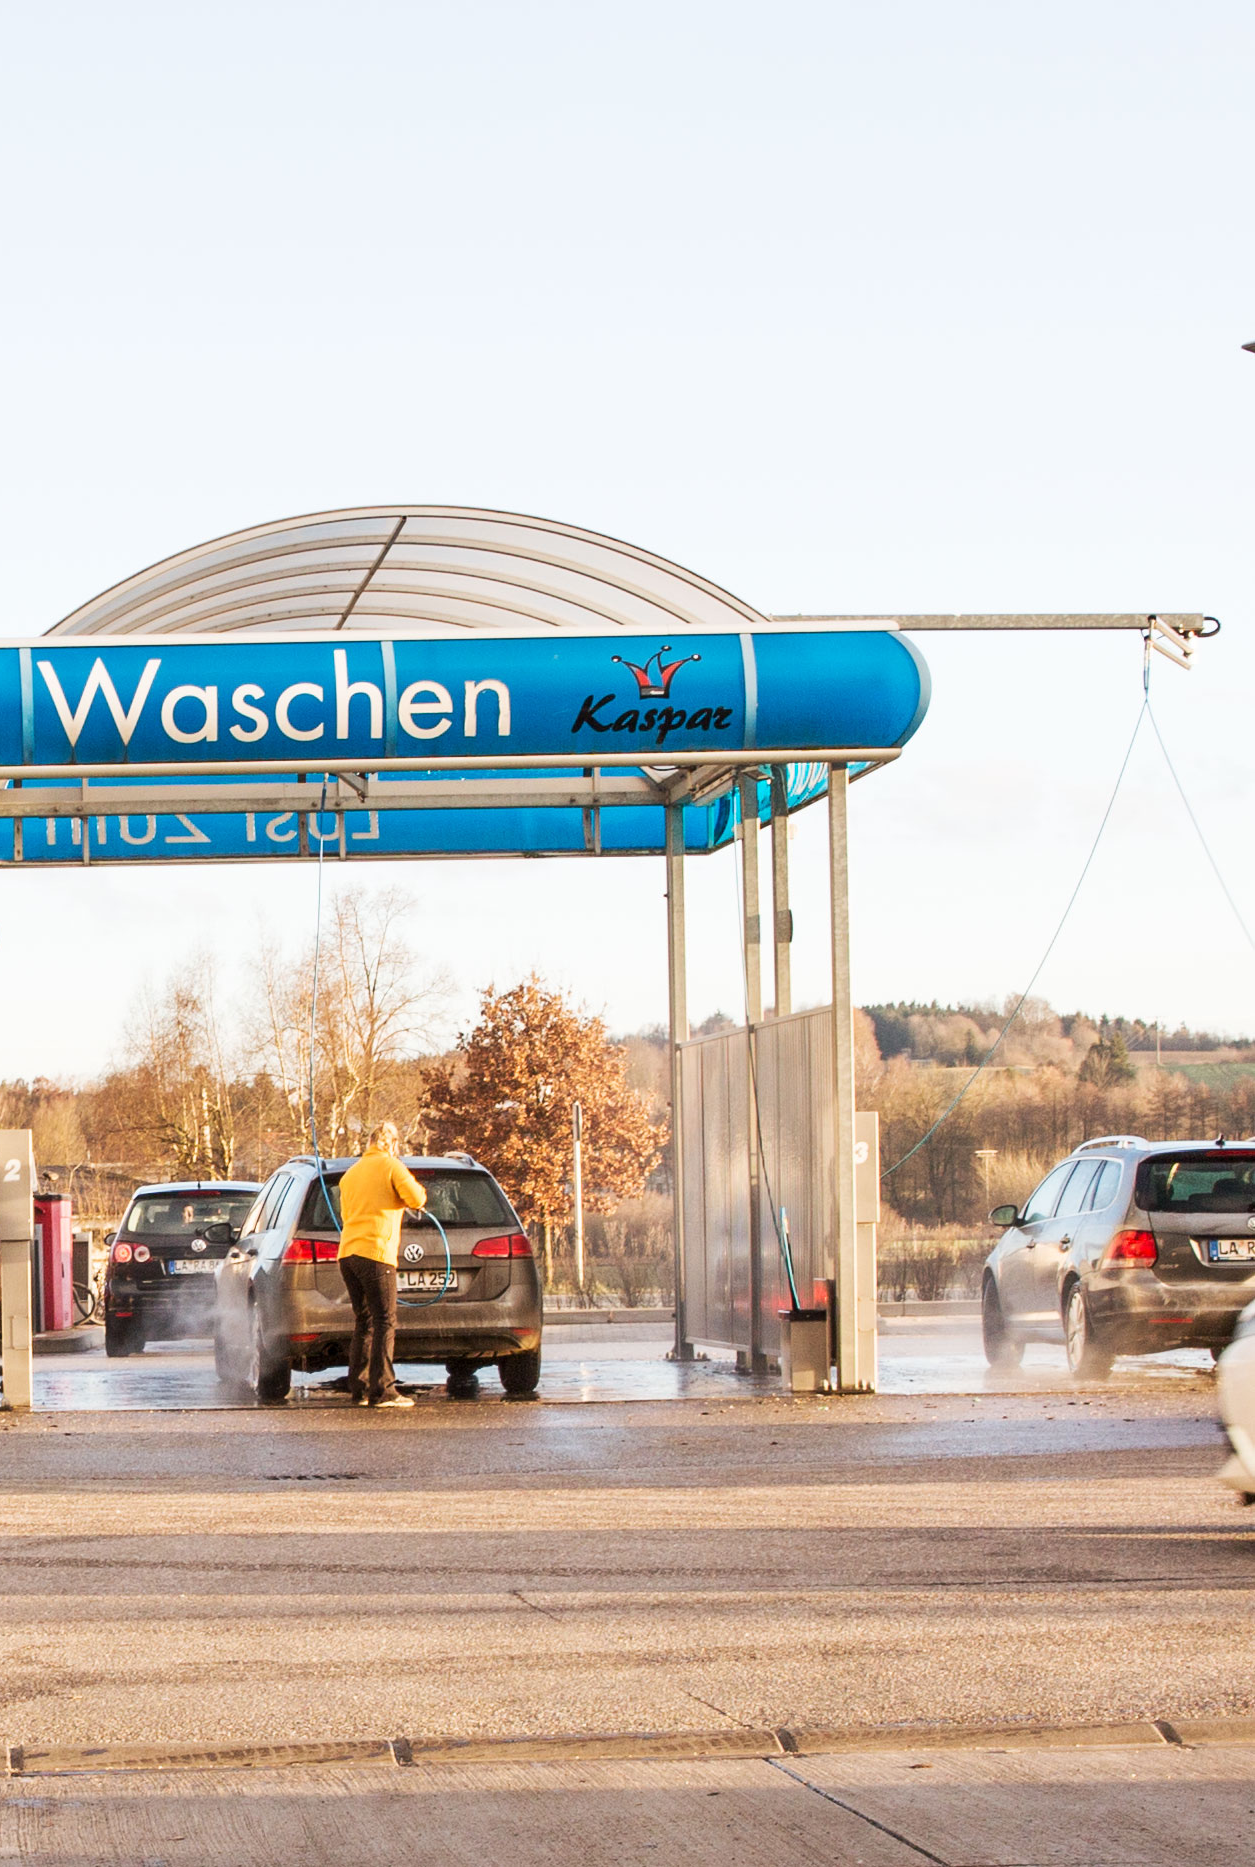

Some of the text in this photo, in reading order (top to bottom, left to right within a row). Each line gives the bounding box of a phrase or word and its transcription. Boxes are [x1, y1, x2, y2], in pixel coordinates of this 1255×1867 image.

[36, 648, 511, 747] Waschen
[571, 693, 734, 745] Kaspar
[853, 1141, 869, 1164] 3
[3, 1158, 22, 1182] 2
[1219, 1241, 1239, 1255] LA
[407, 1272, 426, 1286] LA
